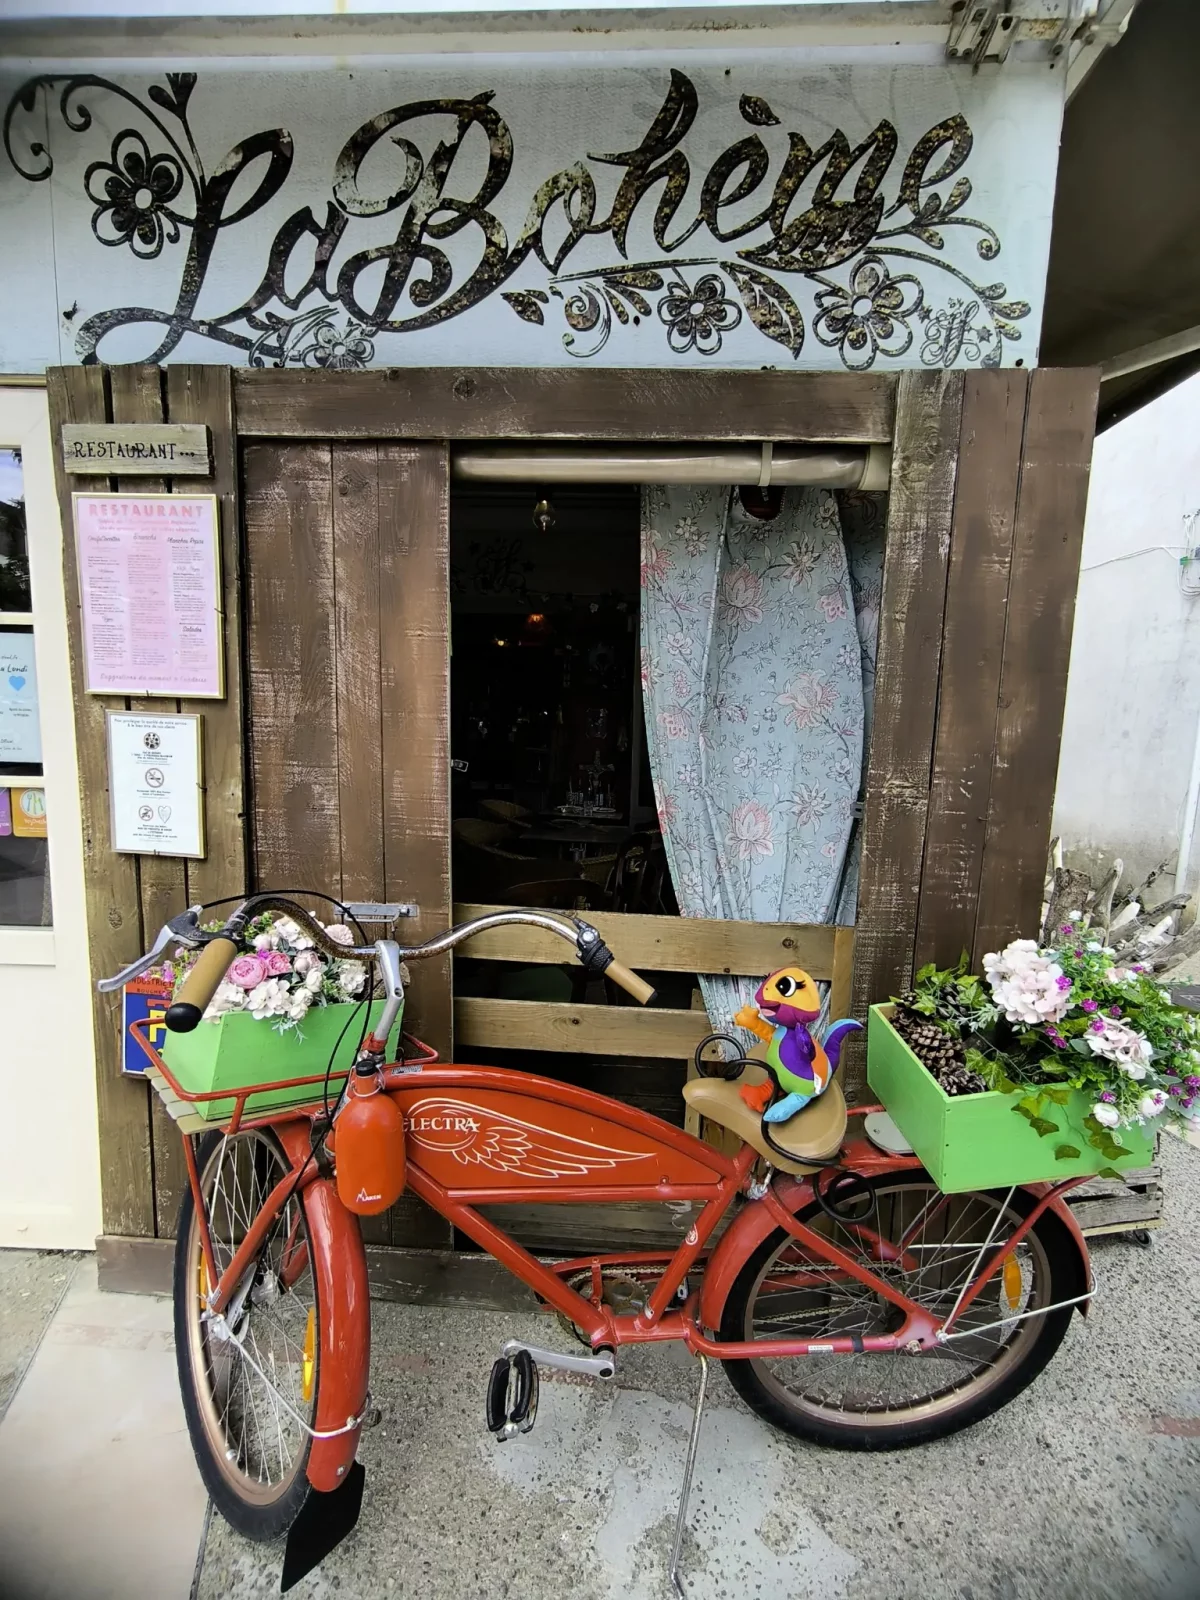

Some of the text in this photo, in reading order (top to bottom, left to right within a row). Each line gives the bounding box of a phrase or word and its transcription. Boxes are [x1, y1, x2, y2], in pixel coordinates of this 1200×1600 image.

[75, 69, 973, 364] La Bohème
[89, 504, 204, 517] RESTAURANT
